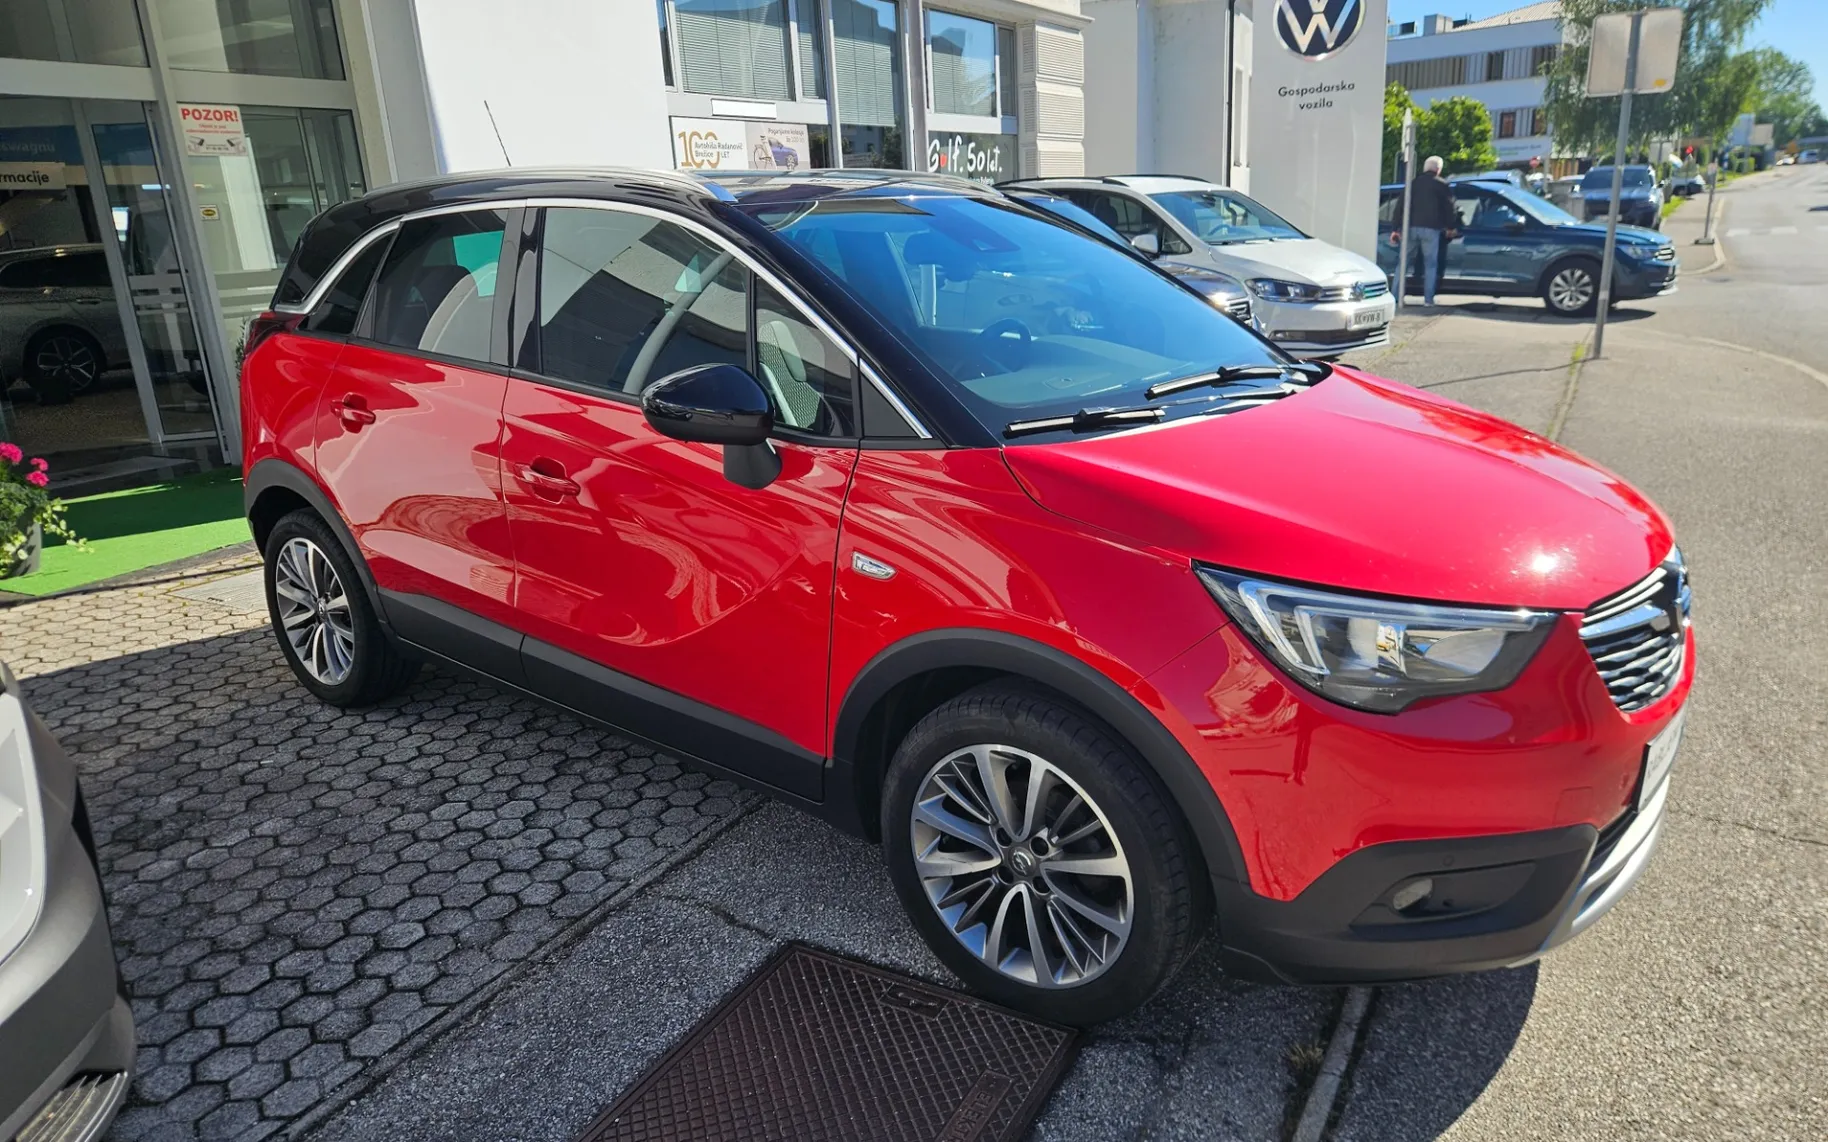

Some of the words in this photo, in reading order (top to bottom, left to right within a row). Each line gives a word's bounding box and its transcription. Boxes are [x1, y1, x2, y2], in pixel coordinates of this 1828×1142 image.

[1278, 80, 1355, 97] Gospodarska
[1299, 98, 1333, 110] vozila
[181, 108, 239, 122] POZOR!
[678, 131, 720, 168] 100
[720, 151, 730, 159] LET
